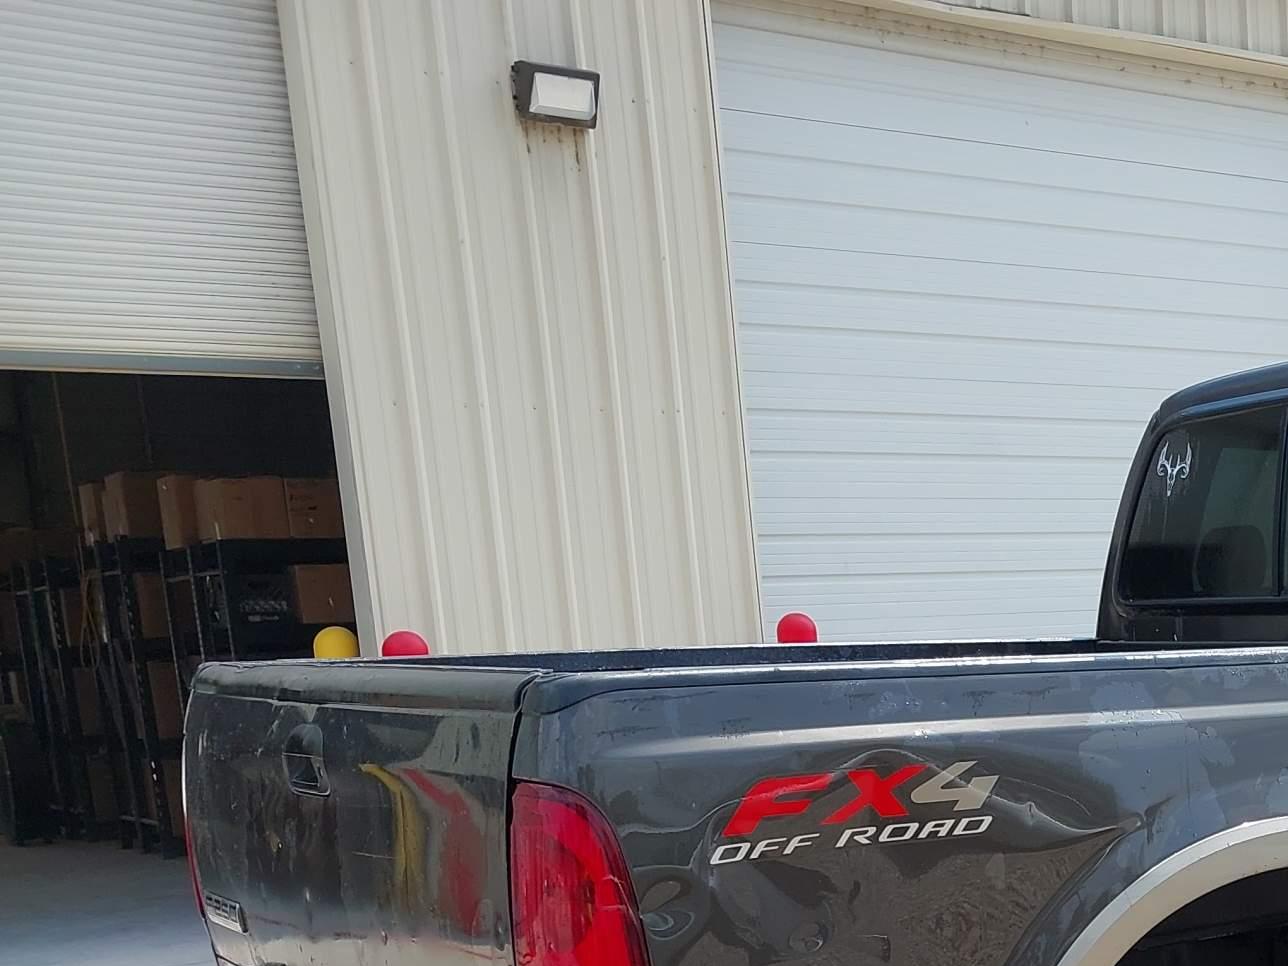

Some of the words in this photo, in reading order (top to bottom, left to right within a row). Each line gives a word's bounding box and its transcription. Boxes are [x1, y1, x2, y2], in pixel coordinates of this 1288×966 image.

[721, 760, 1000, 838] FX4
[709, 833, 821, 866] OFF
[835, 815, 994, 848] ROAD
